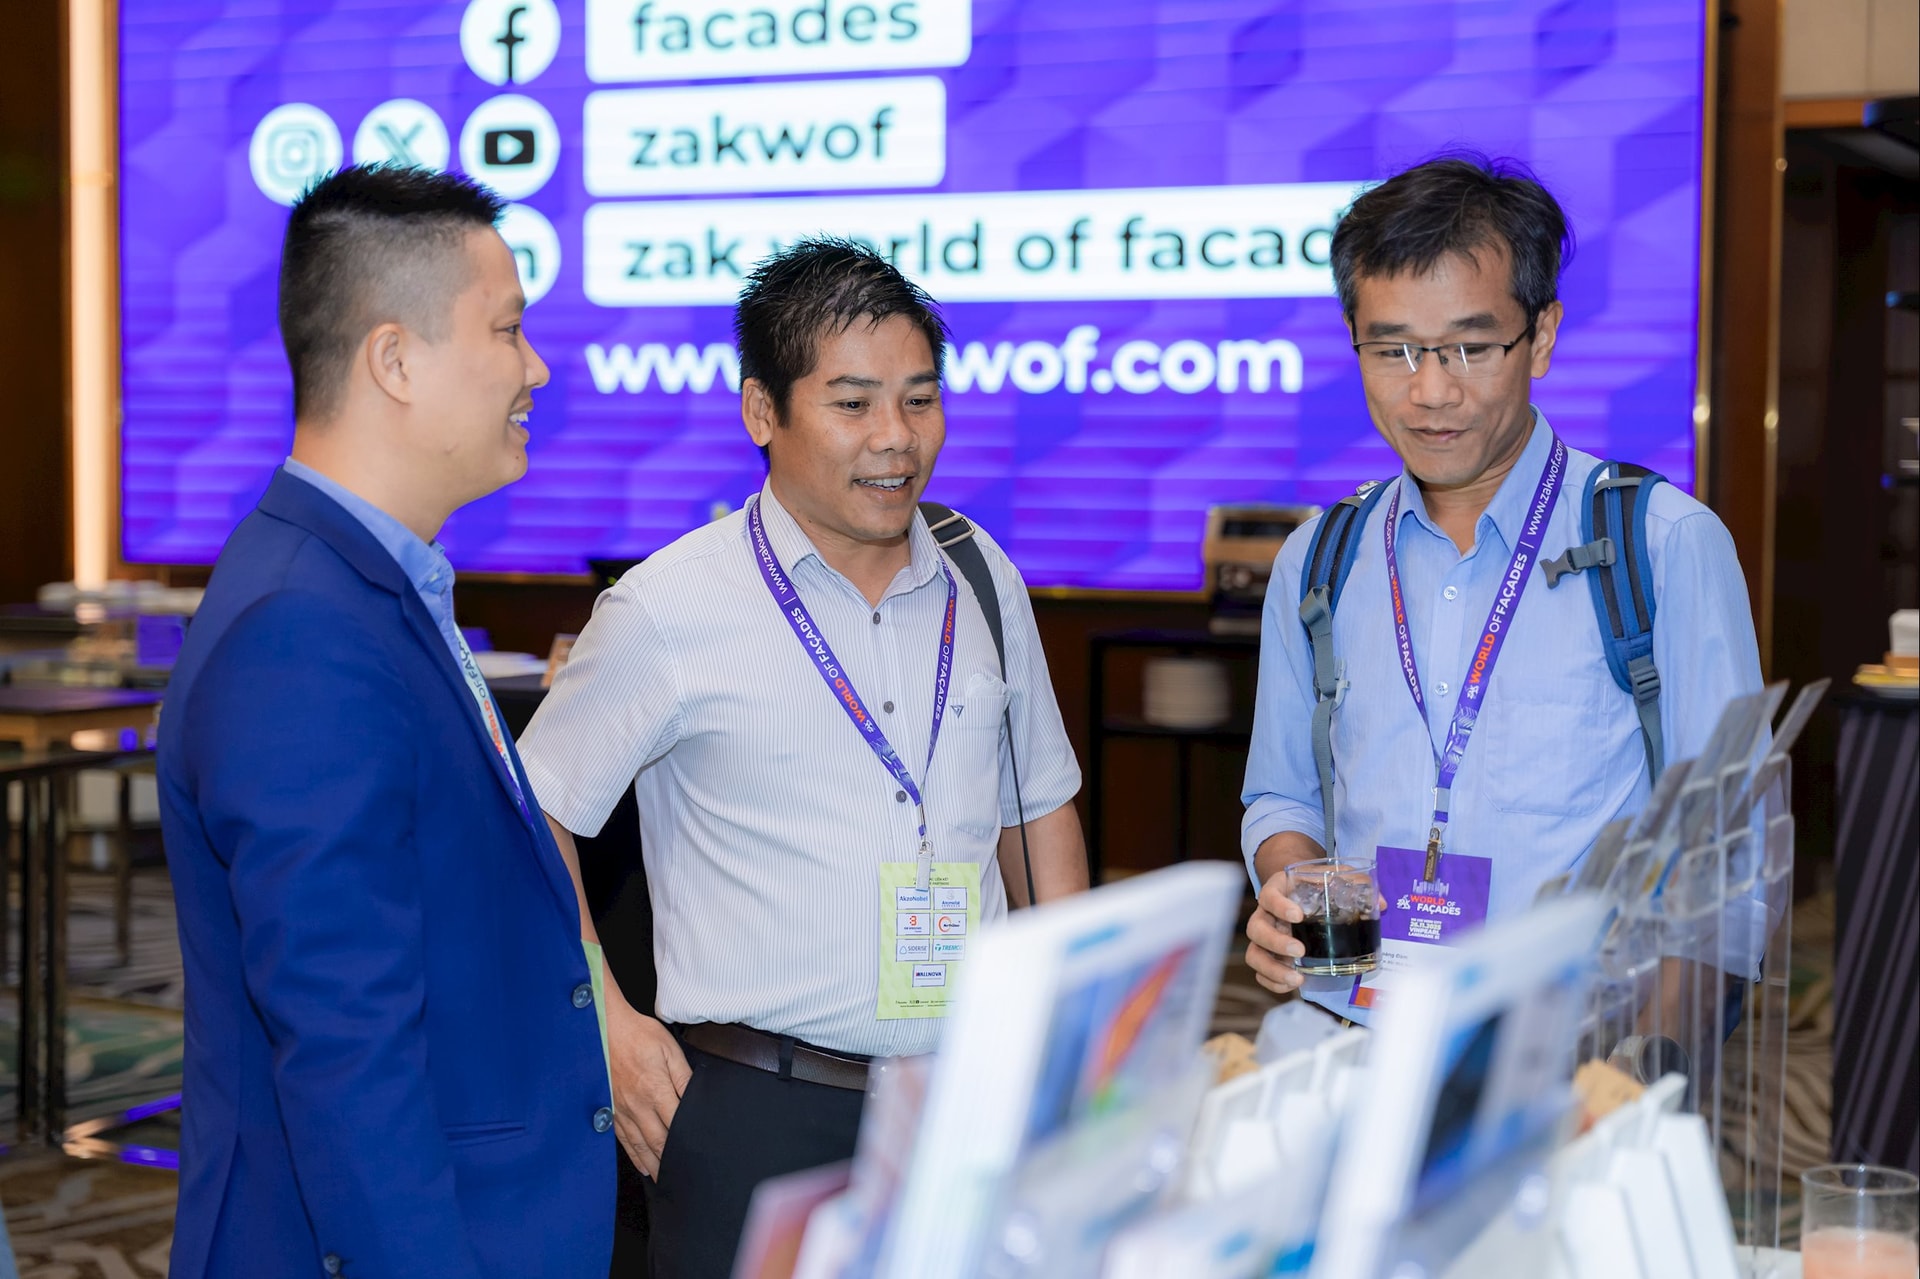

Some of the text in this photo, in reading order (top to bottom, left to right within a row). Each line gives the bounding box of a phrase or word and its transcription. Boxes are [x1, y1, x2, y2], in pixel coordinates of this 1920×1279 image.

[634, 0, 918, 52] facades
[629, 106, 893, 168] zakwof
[623, 228, 742, 279] zak
[1017, 216, 1089, 271] of
[1469, 633, 1496, 684] WORLD
[1489, 613, 1502, 633] OF
[1496, 552, 1528, 615] FAÇADES
[1527, 440, 1563, 535] www.zakwof.com
[944, 599, 955, 644] WORLD
[1392, 577, 1404, 624] WORLD
[791, 607, 830, 663] FAÇADES
[942, 645, 950, 663] OF
[1399, 624, 1408, 641] OF
[474, 680, 486, 698] OF
[824, 662, 839, 679] OF
[935, 662, 948, 720] FAÇADES
[1401, 641, 1421, 703] FAÇADES
[835, 678, 867, 723] WORLD
[1410, 894, 1446, 907] WORLD
[1417, 903, 1461, 915] FAÇADES
